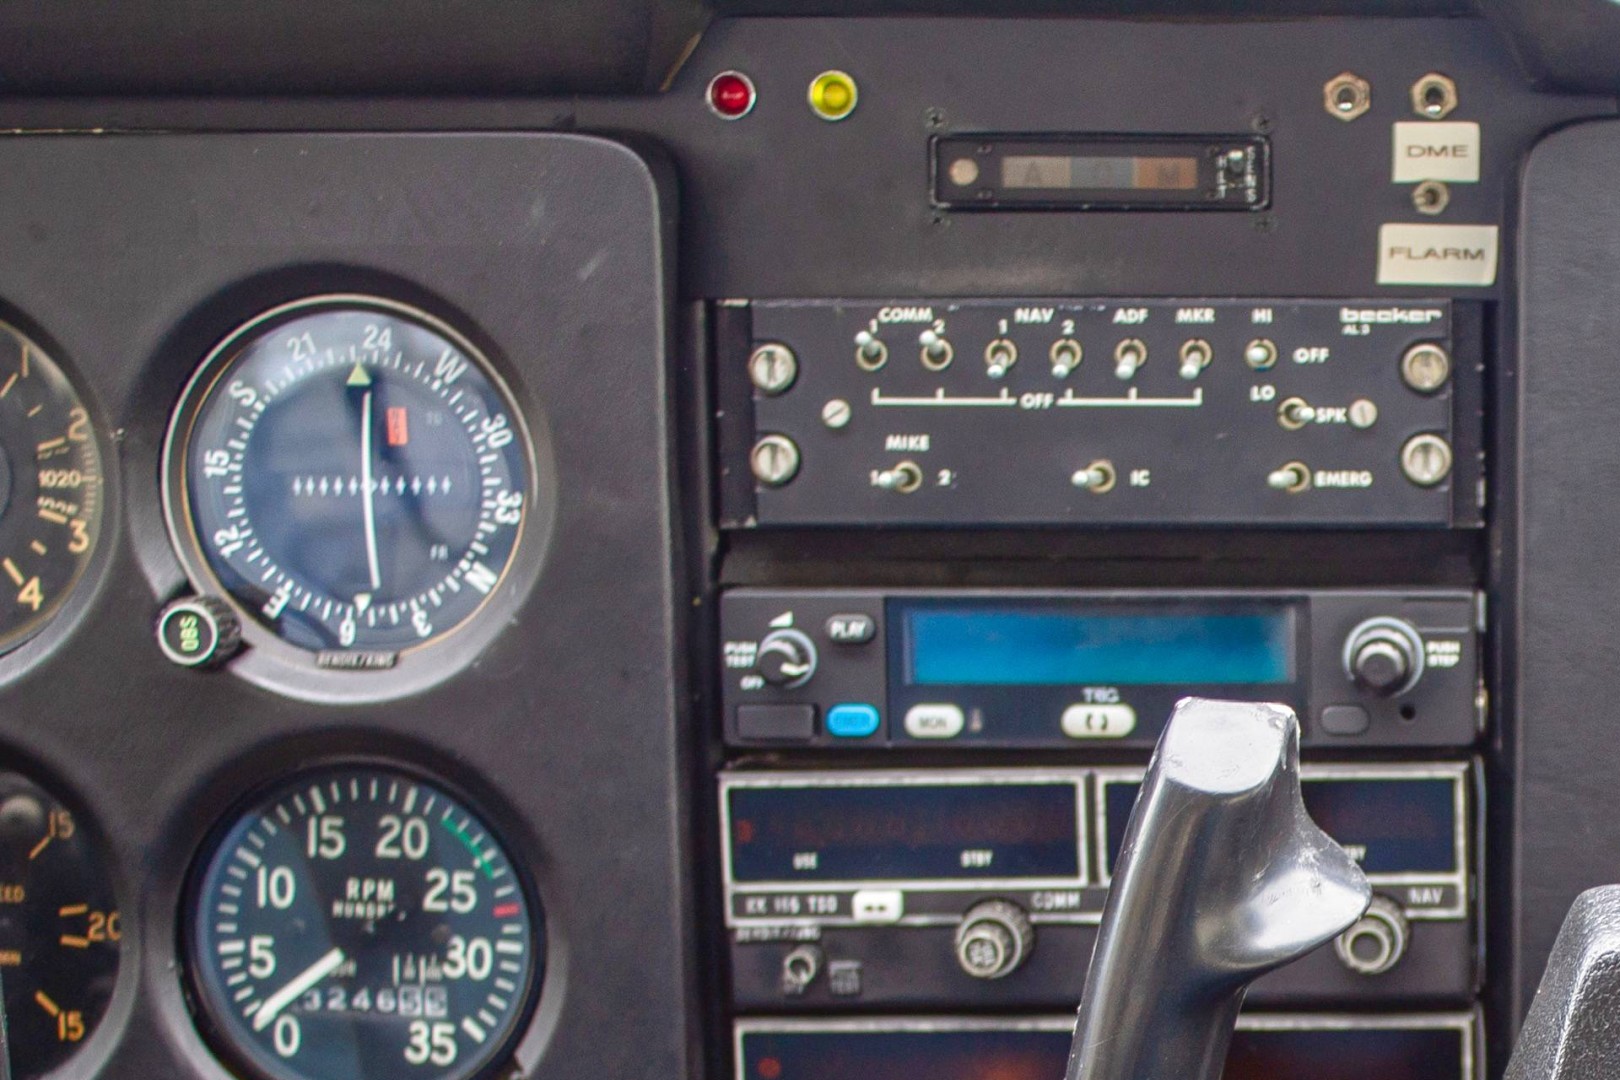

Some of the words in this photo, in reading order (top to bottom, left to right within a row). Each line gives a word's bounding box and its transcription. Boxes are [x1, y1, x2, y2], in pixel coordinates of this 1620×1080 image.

[1405, 143, 1470, 159] DME
[1388, 246, 1486, 261] FLARM
[877, 307, 933, 324] COMM
[1014, 308, 1054, 324] NAV
[1113, 309, 1150, 324] ADF
[1175, 308, 1216, 323] MKR
[1252, 308, 1273, 323] HI
[1340, 308, 1443, 323] becker
[870, 319, 879, 333] 1
[934, 319, 946, 334] 2
[998, 319, 1008, 334] 1
[1062, 320, 1075, 335] 2
[287, 333, 317, 361] 21
[364, 325, 392, 351] 24
[1293, 347, 1329, 363] OFF
[434, 349, 468, 382] W
[230, 381, 257, 407] S
[1020, 393, 1054, 409] OFF
[1250, 385, 1276, 401] LO
[69, 408, 88, 440] 2
[1315, 408, 1347, 423] SPK
[482, 413, 512, 448] 30
[885, 434, 930, 451] MIKE
[205, 450, 231, 478] 15
[39, 471, 81, 487] 1020
[937, 470, 950, 485] 2
[1130, 470, 1151, 486] IC
[1314, 470, 1373, 487] EMERG
[498, 490, 522, 525] 33
[68, 519, 89, 553] 3
[215, 527, 244, 557] 12
[469, 562, 498, 595] N
[18, 577, 44, 611] 4
[413, 609, 432, 637] 3
[830, 621, 866, 638] PLAY
[181, 616, 200, 652] OBS
[918, 716, 948, 729] MON
[49, 811, 74, 838] 15
[307, 817, 346, 859] 15
[376, 817, 429, 859] 20
[793, 853, 818, 869] USE
[257, 866, 295, 909] 10
[346, 877, 394, 901] RPM
[423, 868, 476, 913] 25
[1409, 888, 1443, 905] NAV
[1032, 893, 1081, 909] COMM
[88, 911, 121, 941] 20
[250, 936, 275, 978] 5
[442, 936, 494, 981] 30
[56, 1010, 85, 1042] 15
[274, 1015, 300, 1057] 0
[404, 1021, 457, 1066] 35
